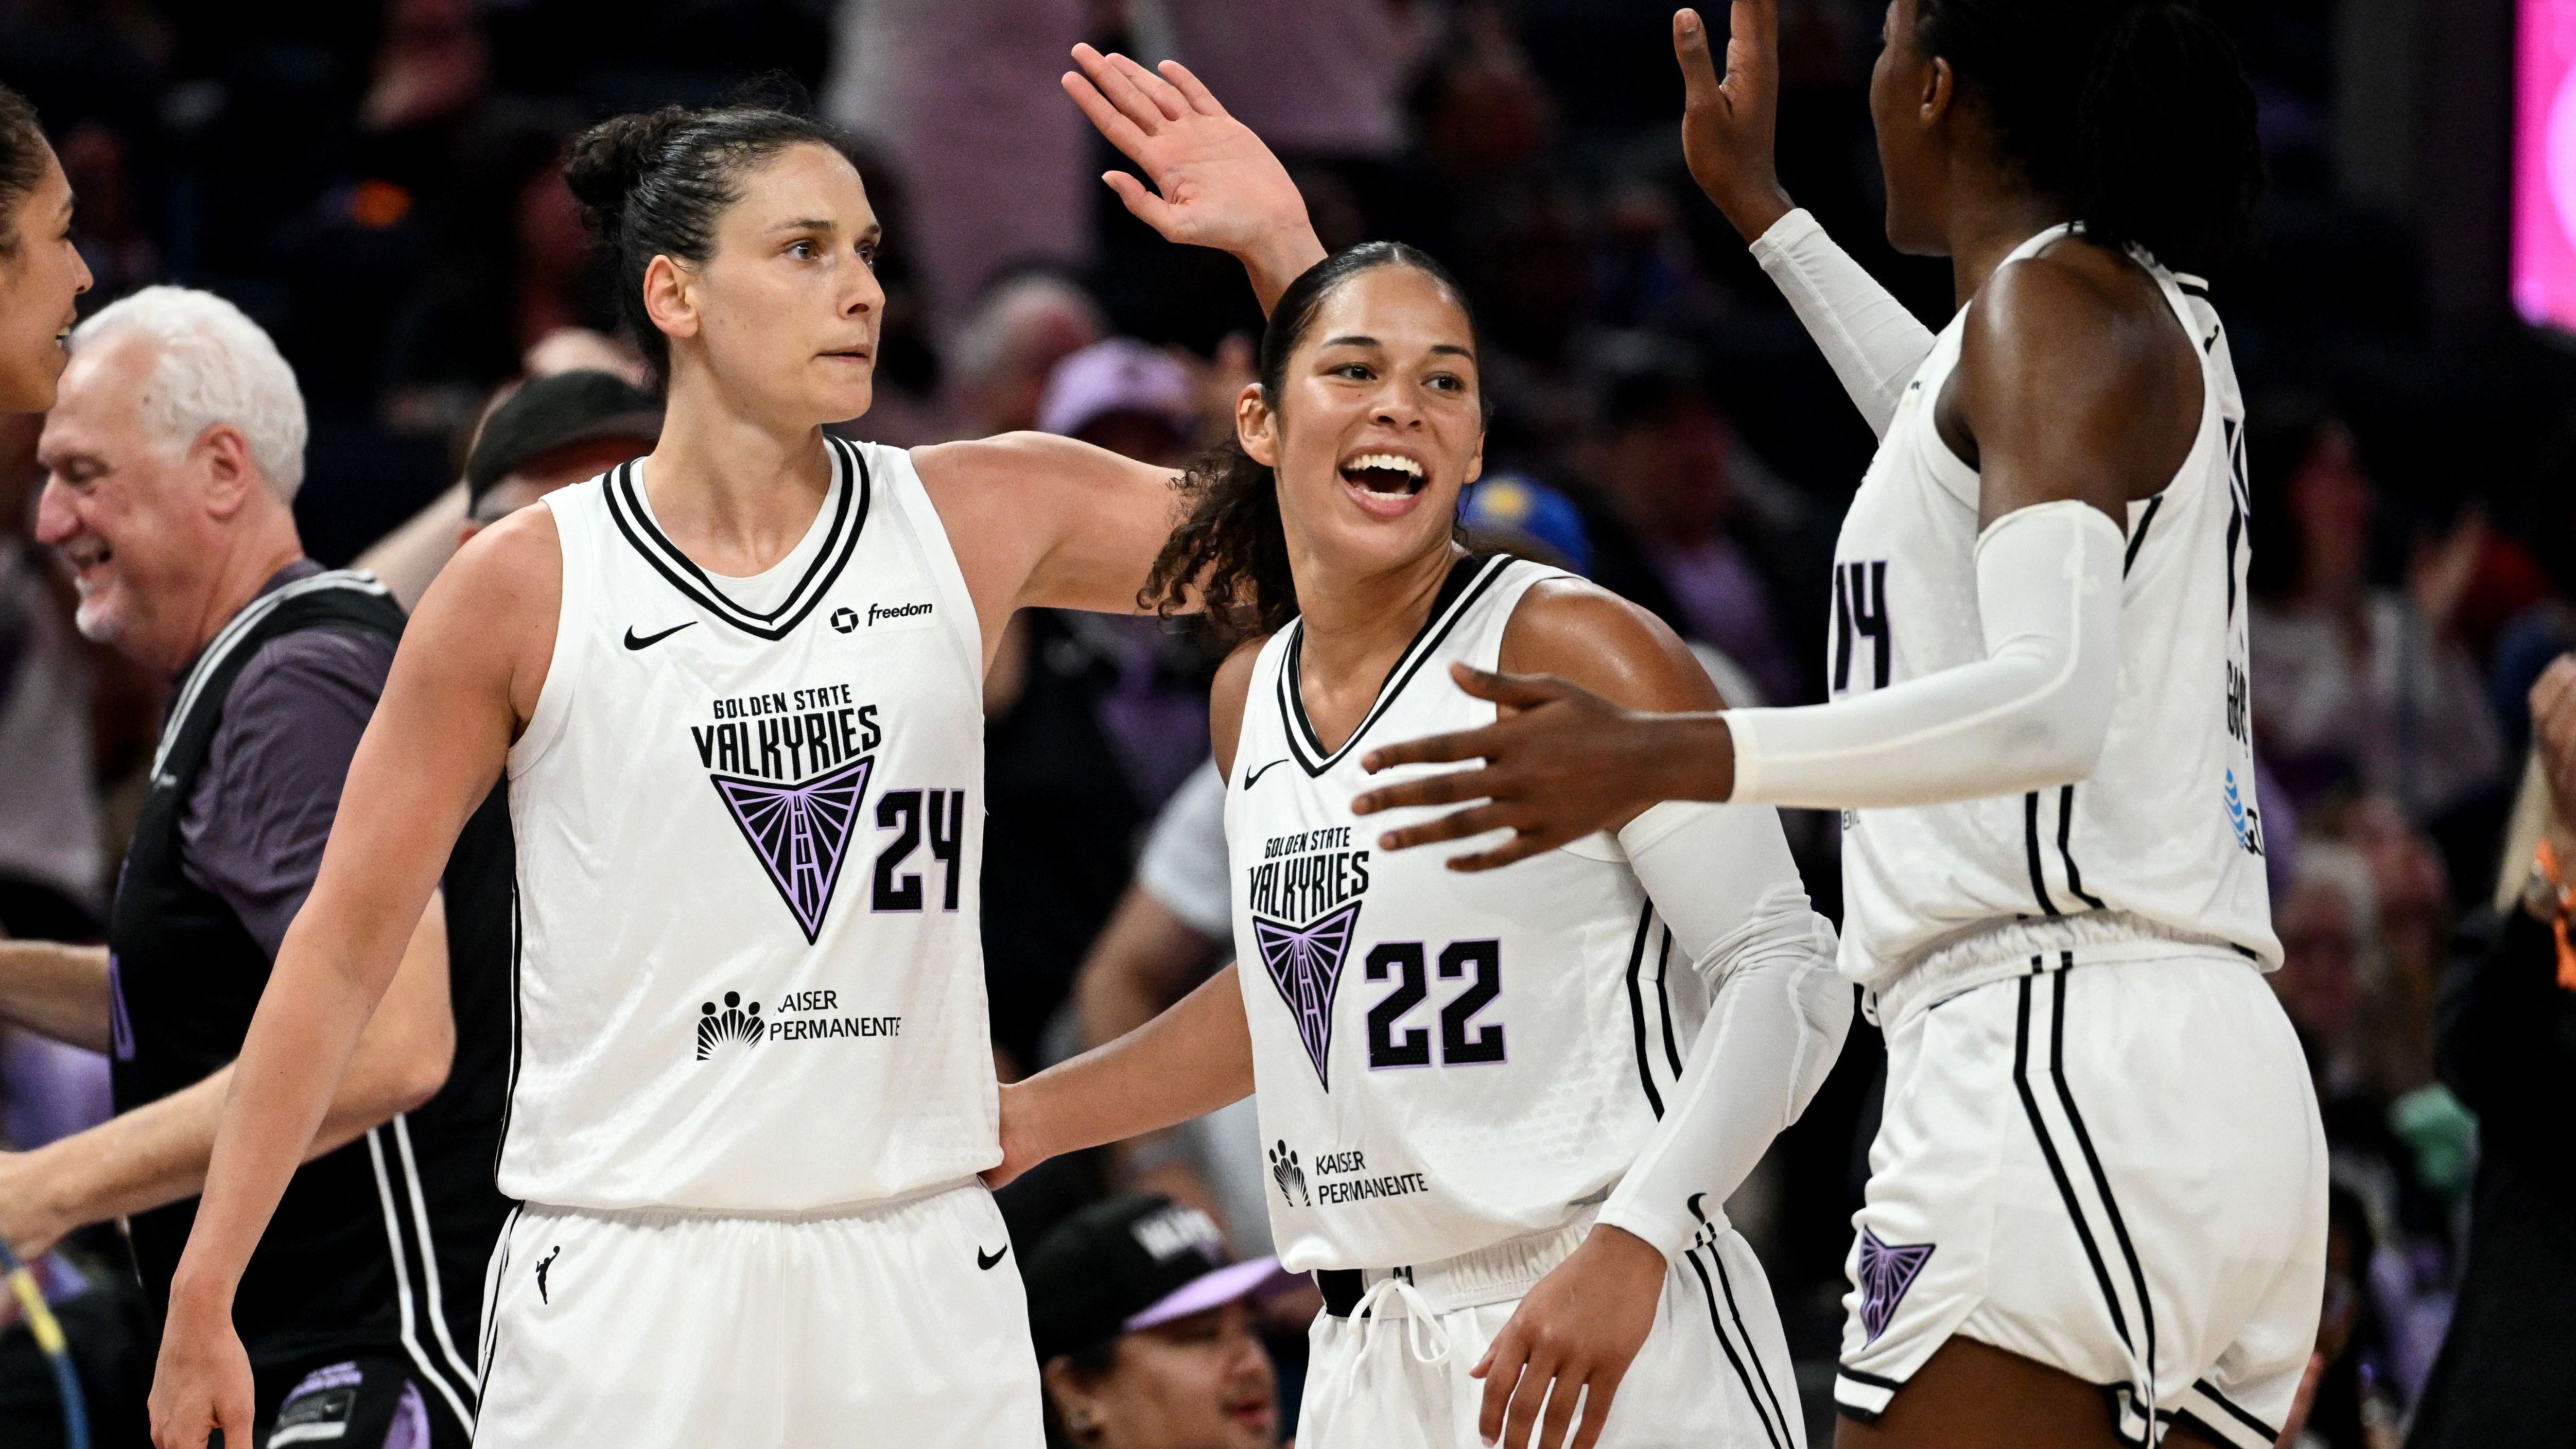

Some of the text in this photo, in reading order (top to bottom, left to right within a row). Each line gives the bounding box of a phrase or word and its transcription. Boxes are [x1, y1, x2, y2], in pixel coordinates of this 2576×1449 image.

[868, 603, 933, 627] freedom
[1834, 560, 1892, 693] 14
[713, 684, 852, 720] GOLDEN STATE
[690, 704, 881, 781] VALKYRIES
[869, 787, 966, 914] 24
[1264, 826, 1351, 859] GOLDEN STATE
[1247, 850, 1369, 924] VALKYRIES
[777, 990, 838, 1013] AISER
[1363, 936, 1508, 1072] 22
[770, 1017, 901, 1041] PERMANENTE
[1316, 1150, 1366, 1176] KAISER
[1318, 1173, 1429, 1206] PERMANENTE
